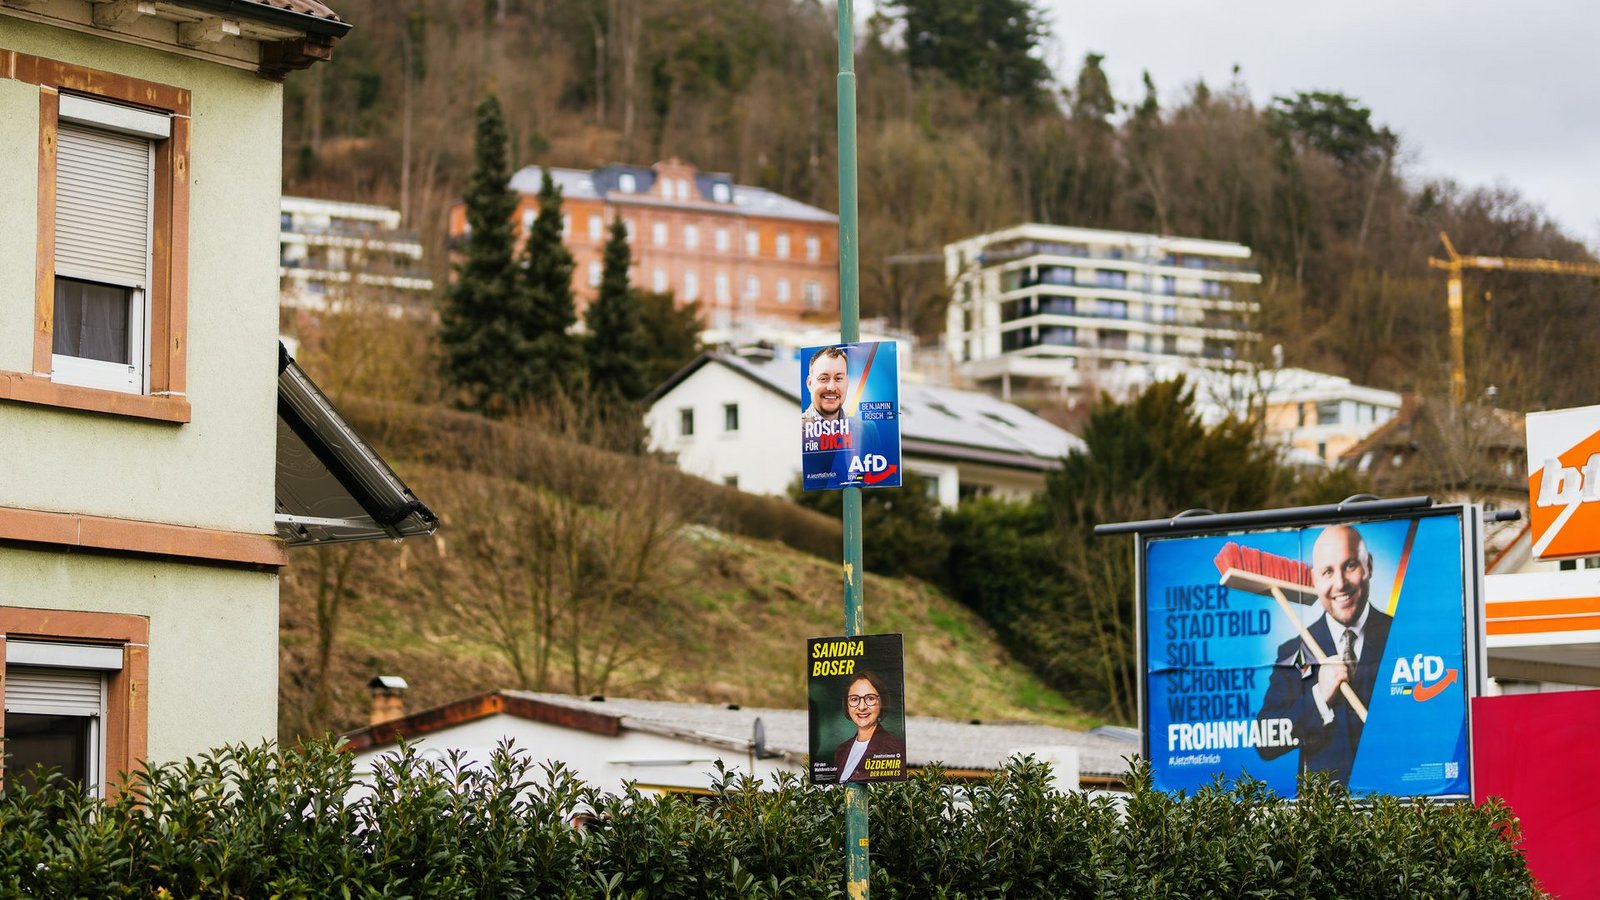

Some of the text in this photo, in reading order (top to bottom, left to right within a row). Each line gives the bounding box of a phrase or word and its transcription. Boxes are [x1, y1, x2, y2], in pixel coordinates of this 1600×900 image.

[862, 402, 891, 411] BENJAMIN
[864, 411, 884, 420] RÖSCH
[806, 417, 849, 437] RÖSCH
[805, 432, 852, 452] FÜR DICH
[849, 454, 887, 472] AfD
[1166, 585, 1228, 611] UNSER
[1166, 609, 1271, 640] STADTBILD
[813, 641, 864, 658] SANDRA
[1168, 641, 1214, 666] SOLL
[813, 660, 855, 676] BOSER
[1392, 654, 1444, 683] AfD
[1168, 693, 1256, 721] WERDEN.
[1168, 718, 1299, 751] FROHNMAIER.
[864, 758, 902, 770] ÖZDEMIR
